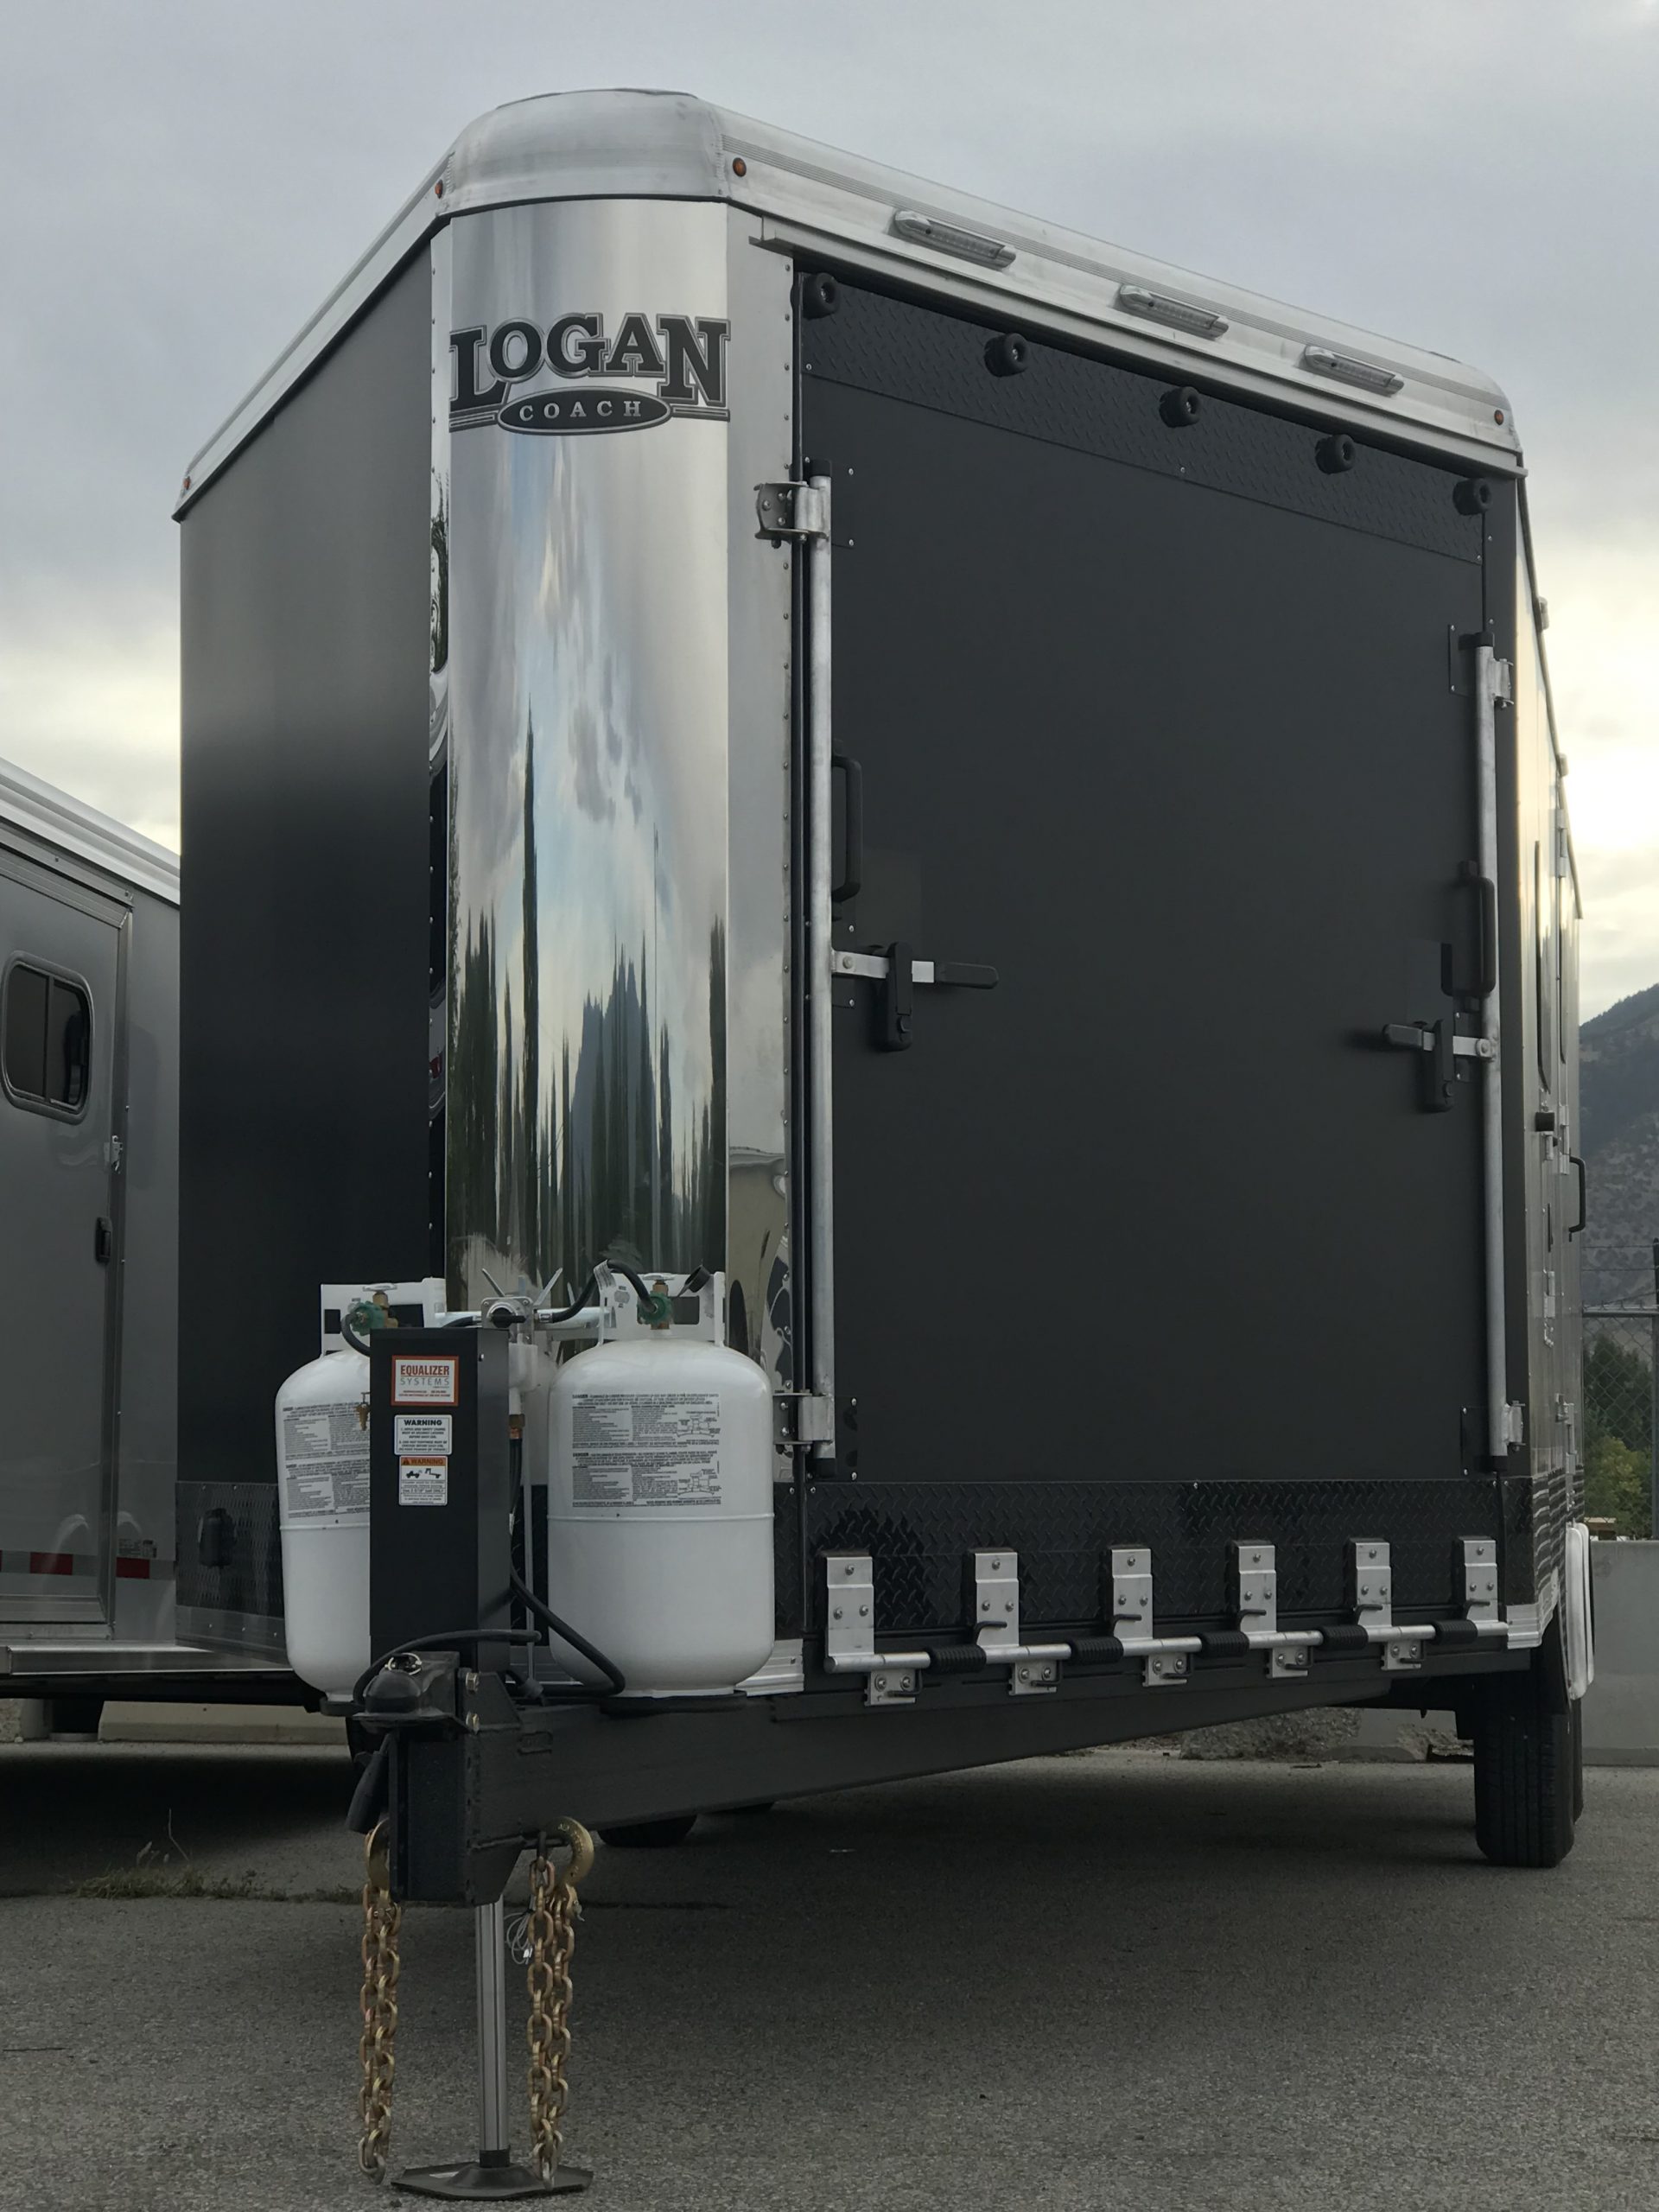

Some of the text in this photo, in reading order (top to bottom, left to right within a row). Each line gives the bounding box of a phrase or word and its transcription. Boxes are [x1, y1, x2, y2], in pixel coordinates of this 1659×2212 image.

[449, 312, 731, 413] LOGAN
[519, 401, 641, 422] COACH
[400, 1364, 449, 1376] EQUALIZER
[400, 1376, 449, 1385] SYSTEMS
